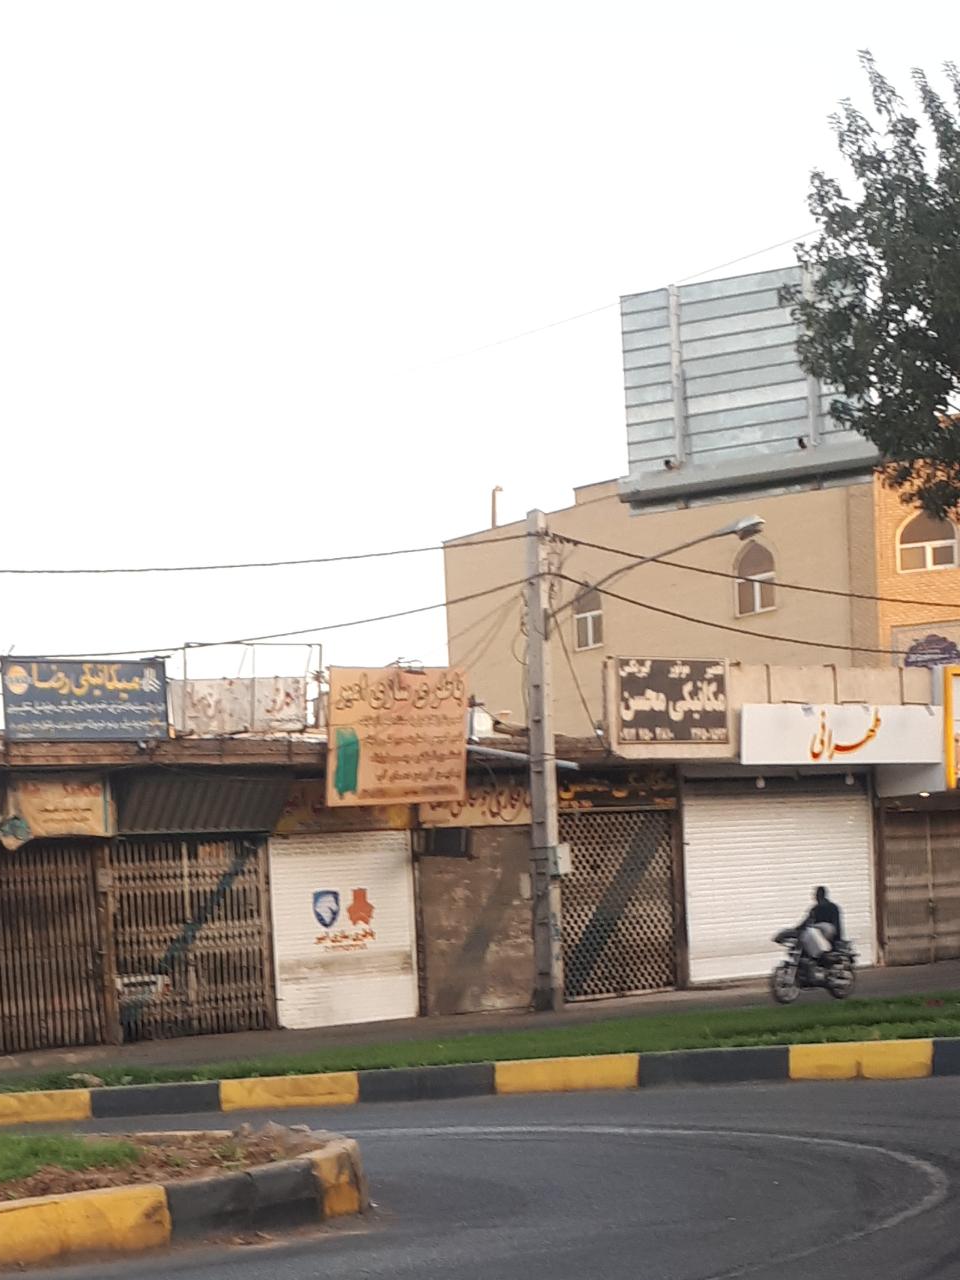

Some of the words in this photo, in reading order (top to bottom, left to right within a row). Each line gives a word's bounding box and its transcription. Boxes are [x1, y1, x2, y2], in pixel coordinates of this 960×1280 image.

[32, 663, 71, 695] رضا
[335, 672, 367, 711] امیر
[620, 689, 667, 721] محسن
[668, 681, 725, 721] مکانیکی
